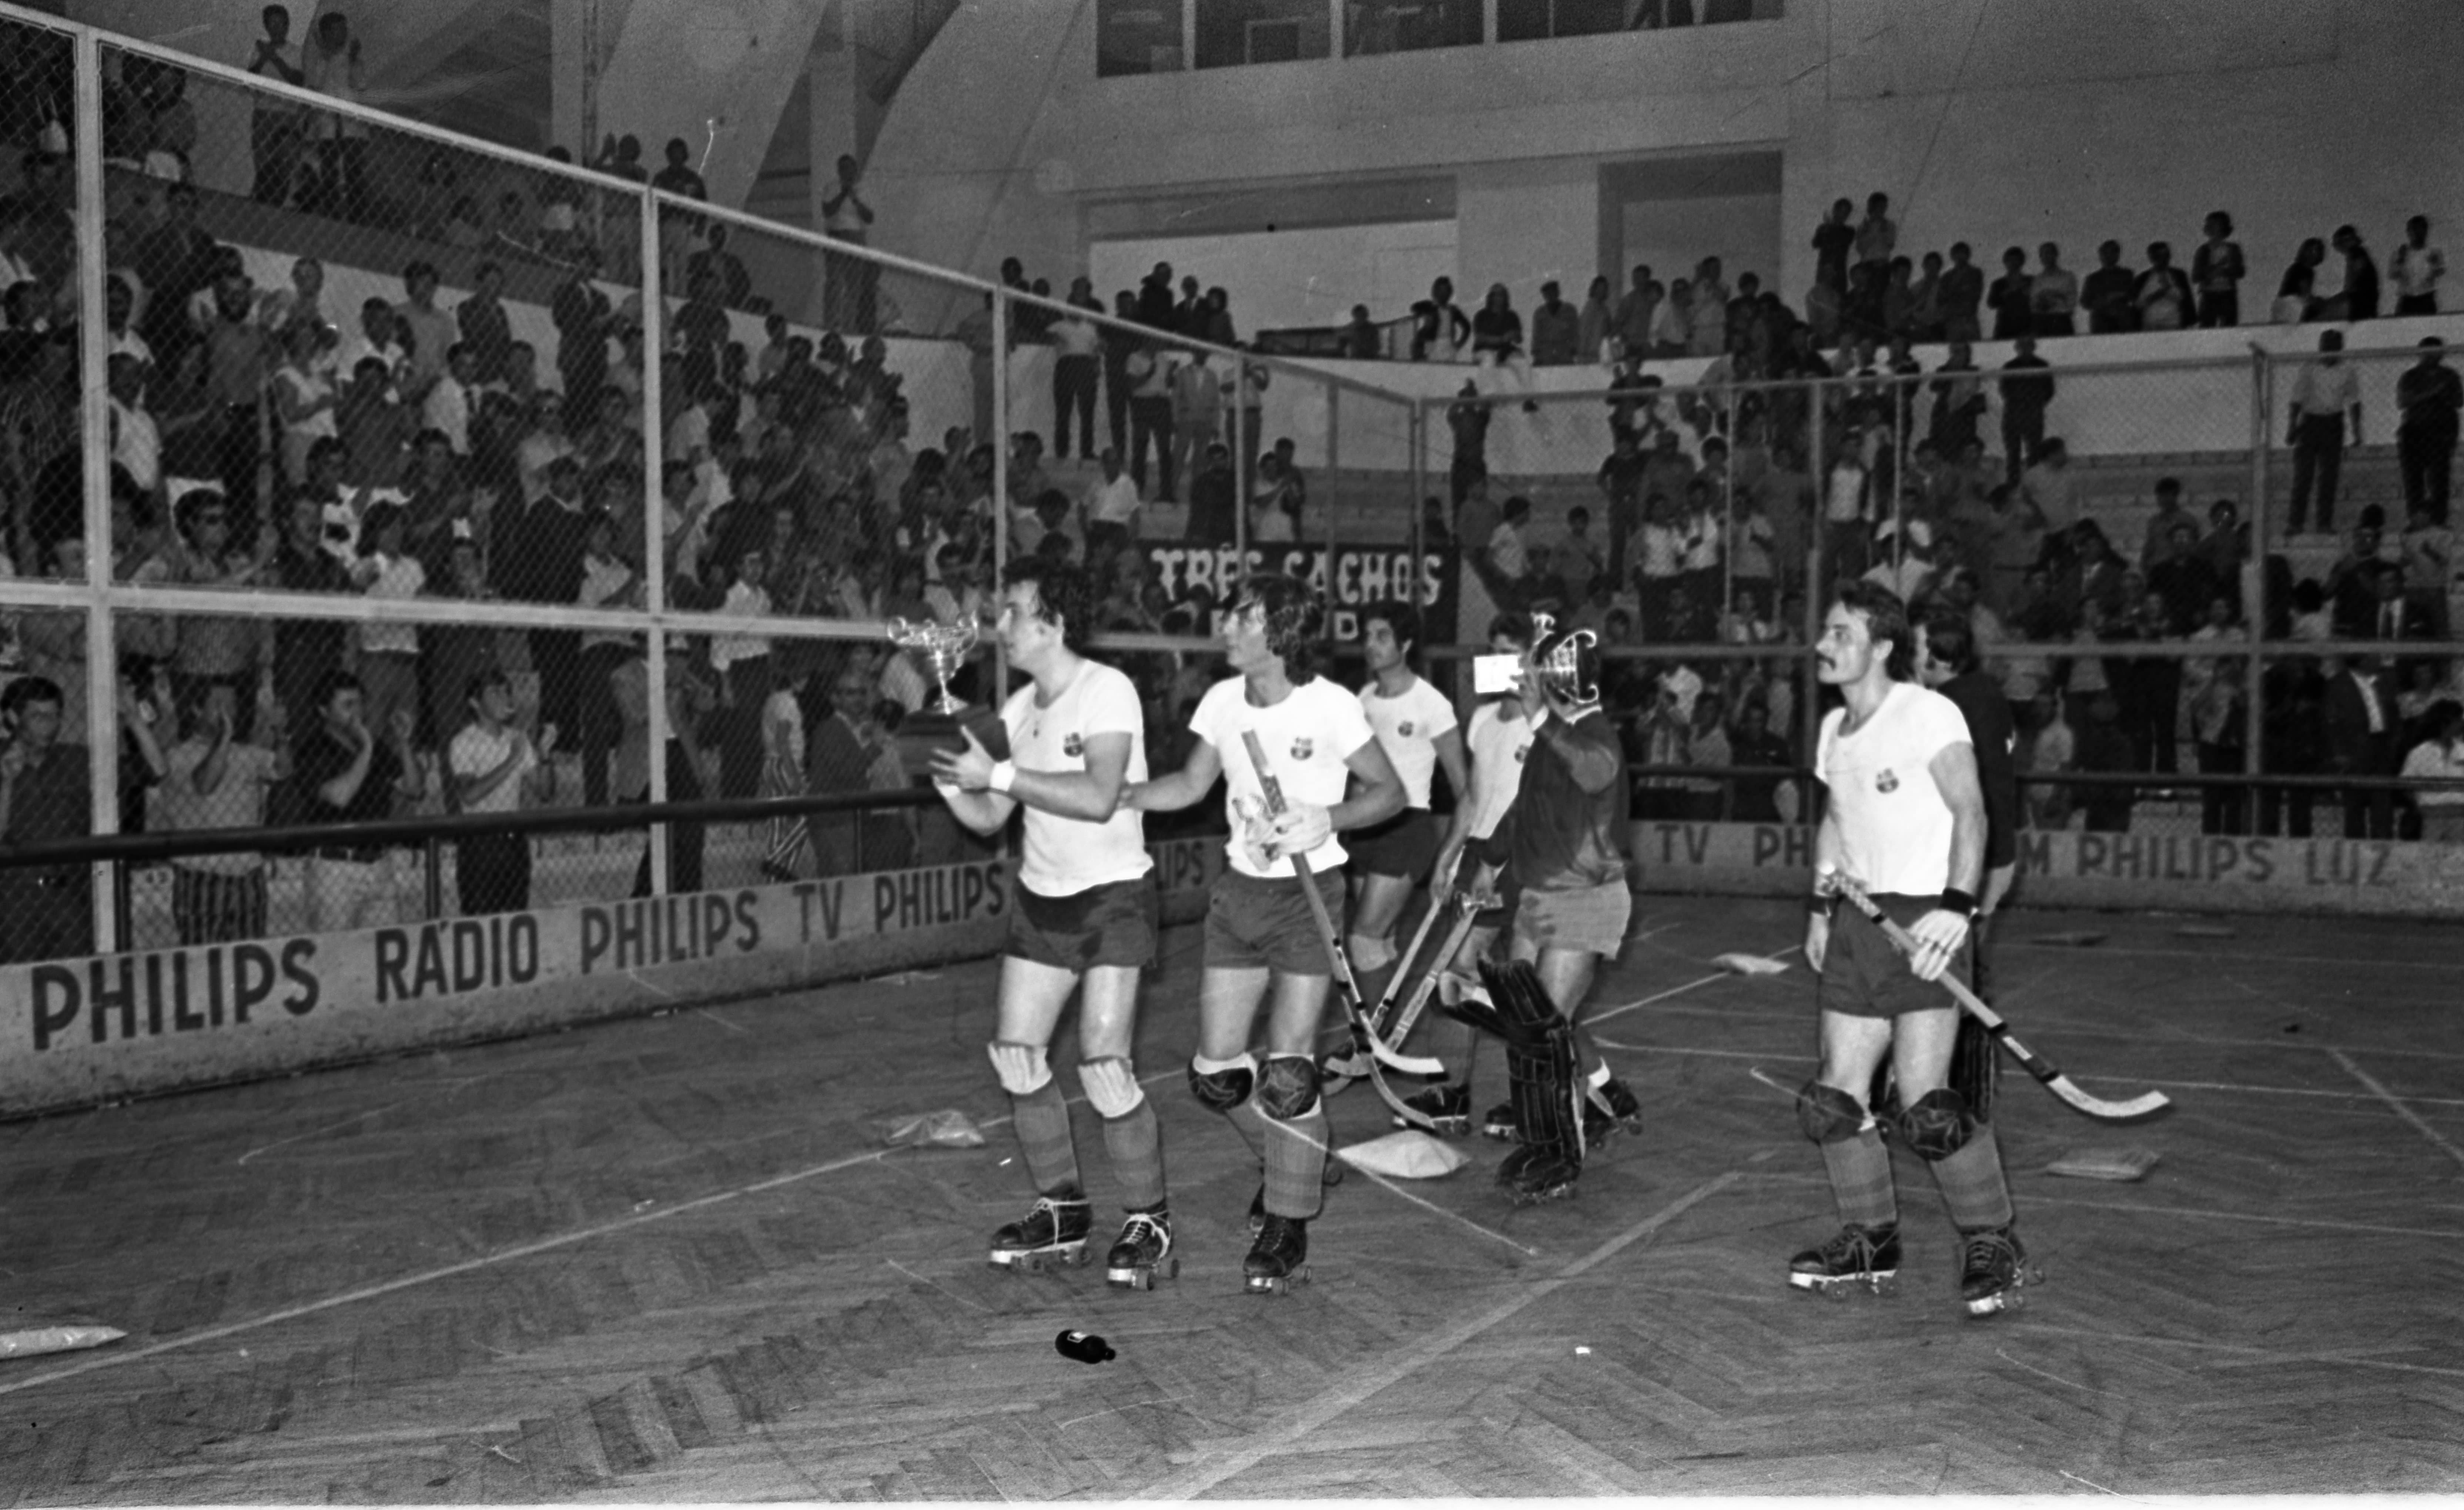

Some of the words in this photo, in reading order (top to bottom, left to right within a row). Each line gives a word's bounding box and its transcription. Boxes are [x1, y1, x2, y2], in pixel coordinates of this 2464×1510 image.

[1656, 824, 1709, 865] TV
[2078, 835, 2275, 883] PHILIPS
[2306, 840, 2397, 887] LUZ
[31, 938, 320, 1050] PHILIPS
[580, 890, 760, 974] PHILIPS
[793, 881, 843, 943] TV
[875, 864, 1004, 933] PHILIPS
